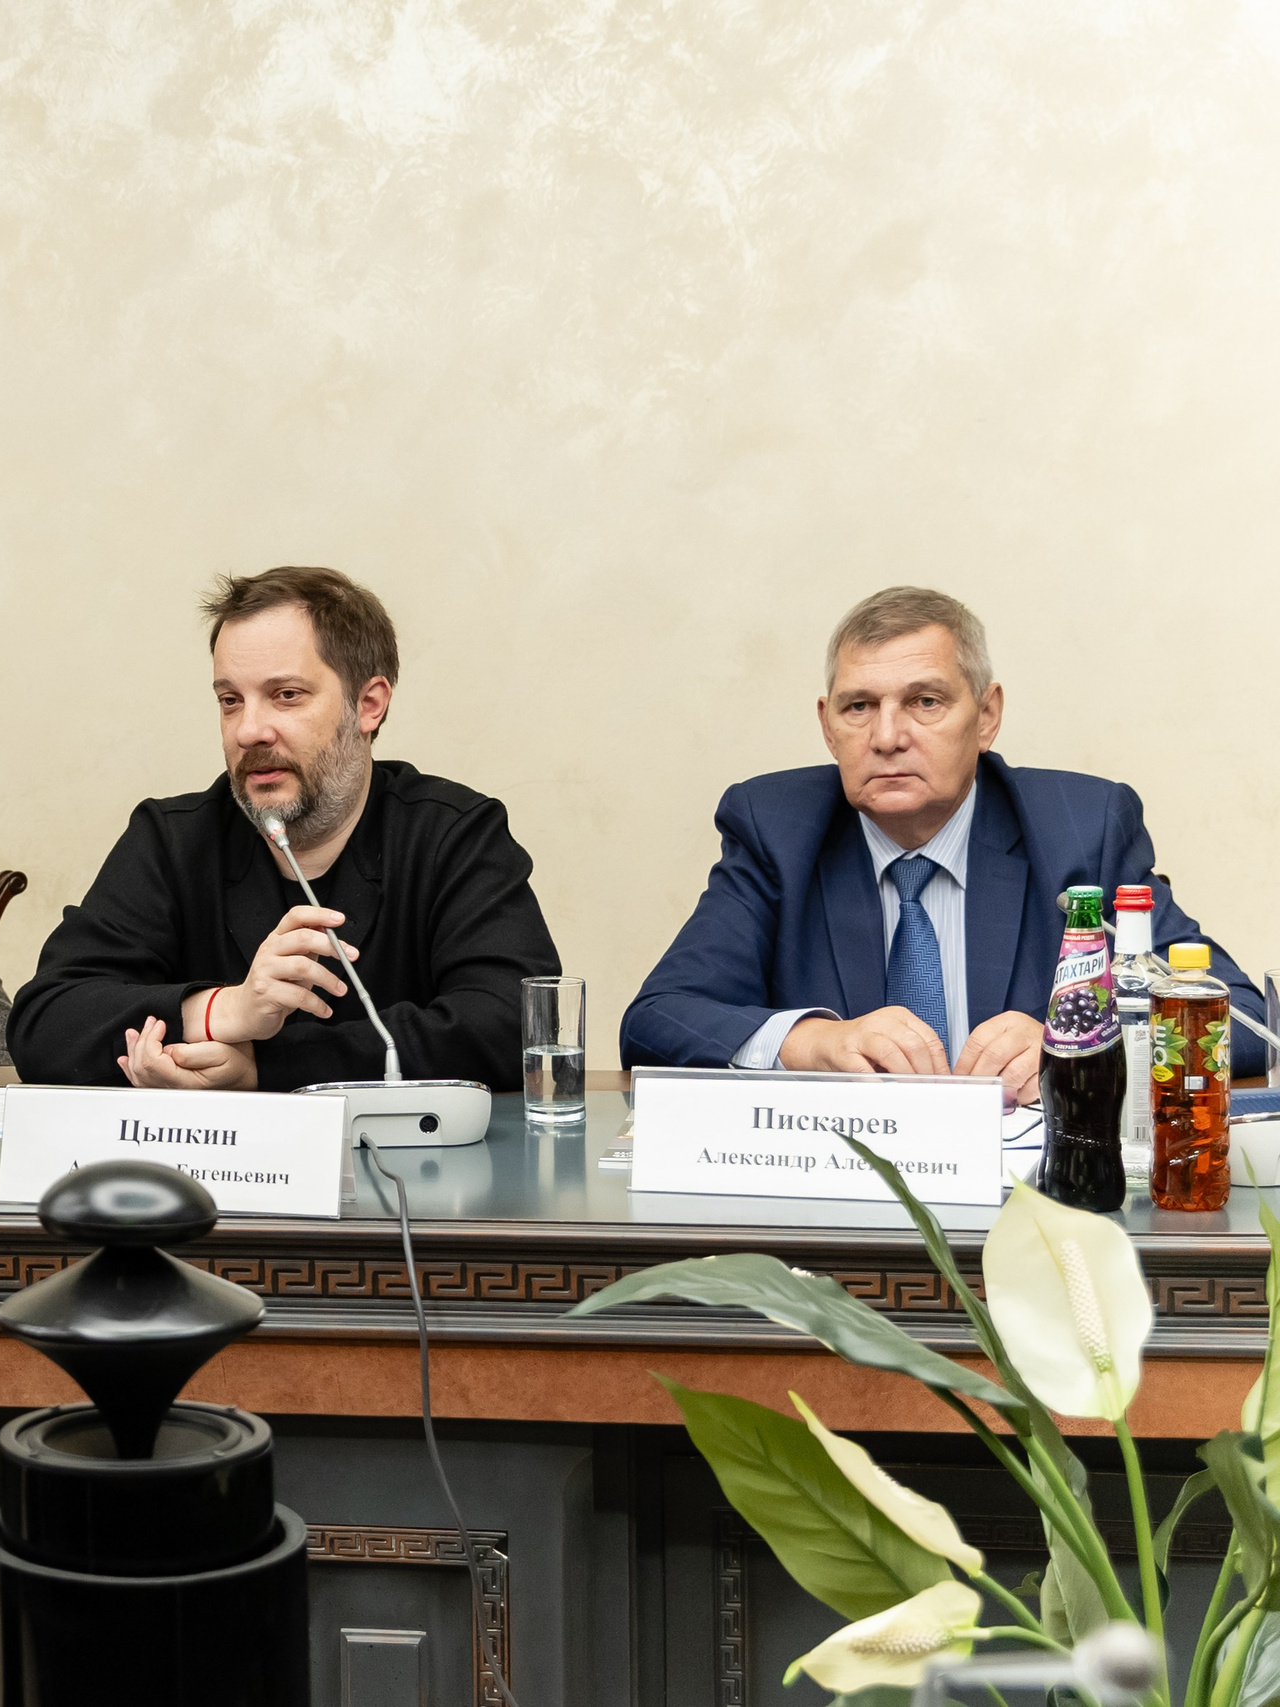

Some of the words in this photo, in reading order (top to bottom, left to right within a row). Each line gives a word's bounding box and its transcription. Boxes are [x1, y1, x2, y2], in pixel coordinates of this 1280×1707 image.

[118, 1119, 238, 1147] Цыпкин
[751, 1106, 898, 1138] Пискарев
[696, 1147, 817, 1173] Александр
[824, 1153, 959, 1175] Алееевич
